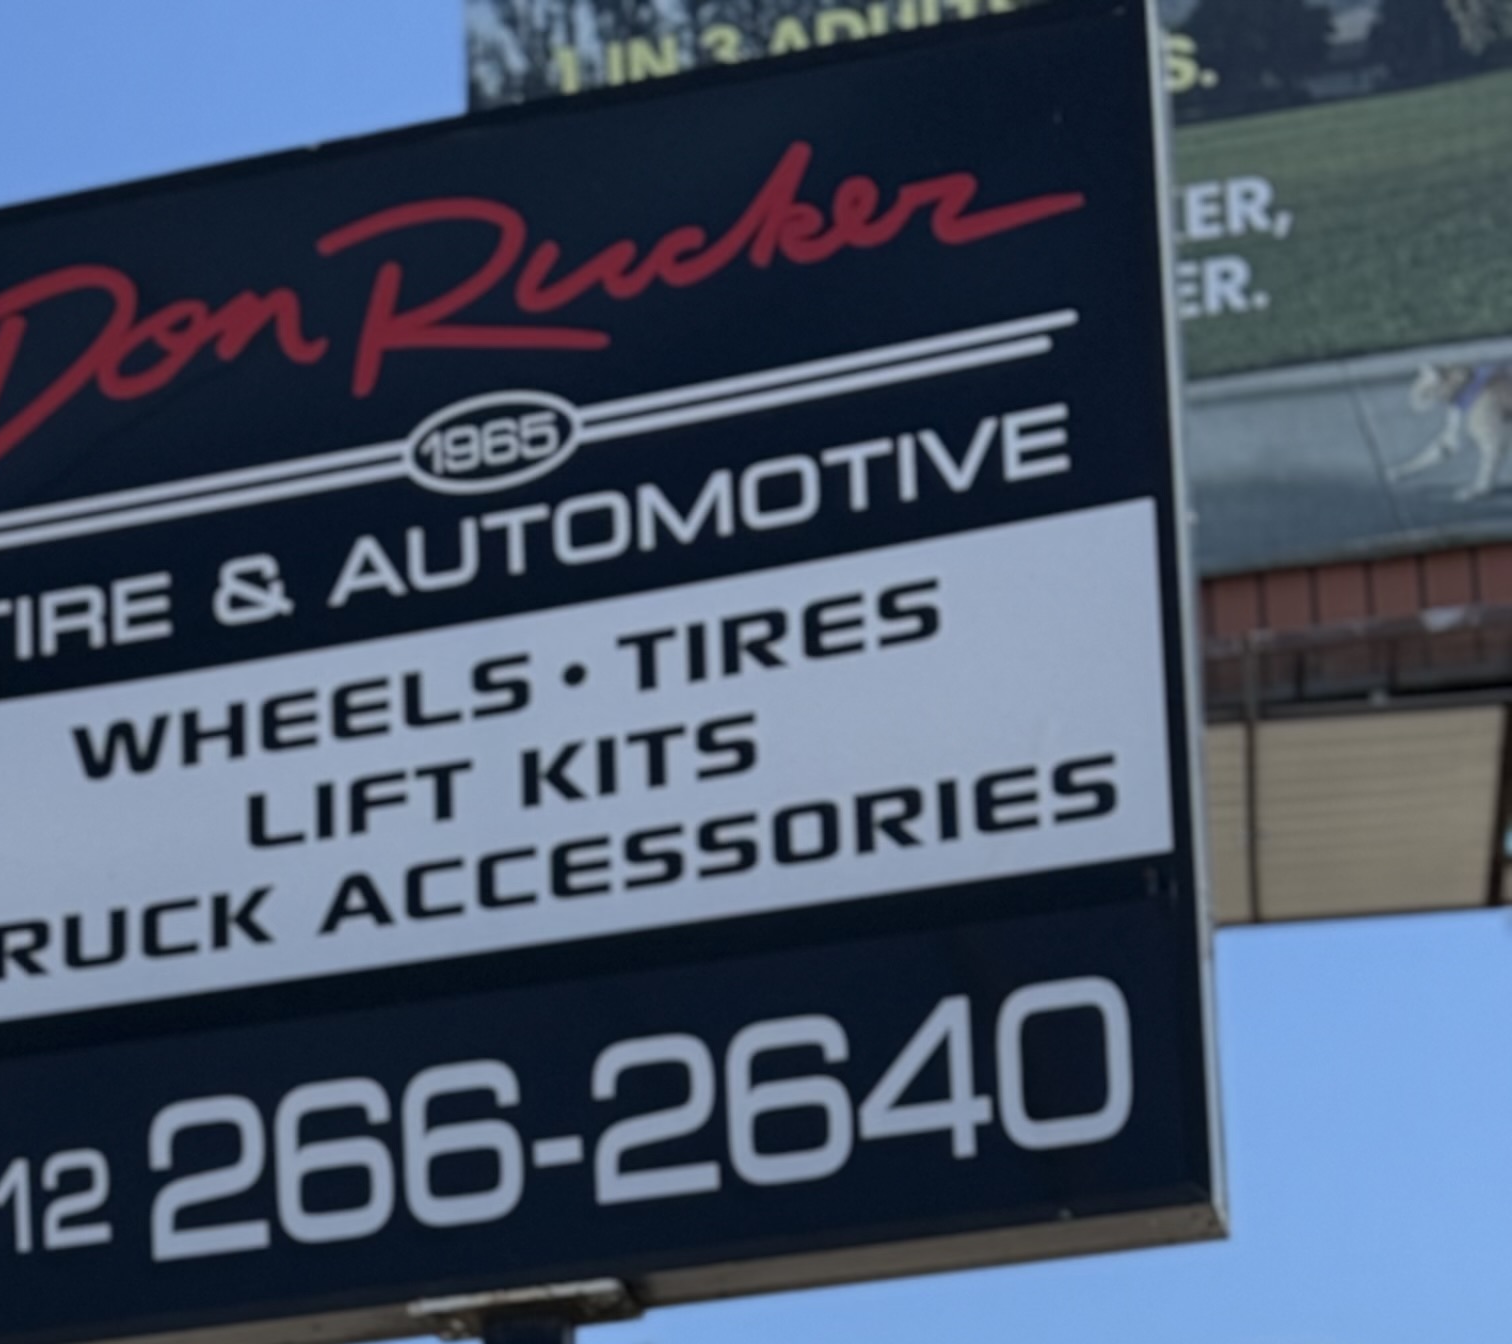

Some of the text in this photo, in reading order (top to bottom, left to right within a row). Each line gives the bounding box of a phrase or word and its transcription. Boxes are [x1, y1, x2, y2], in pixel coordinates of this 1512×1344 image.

[607, 34, 680, 86] IN
[317, 142, 1088, 396] Rucker
[213, 553, 294, 626] &
[328, 403, 1071, 607] AUTOMOTIVE
[419, 410, 561, 476] 1965
[71, 578, 941, 781] WHEELS TIRES
[247, 712, 758, 850] LIFT KITS
[318, 753, 1118, 936] ACCESSORIES
[148, 976, 1133, 1261] 266-2640
